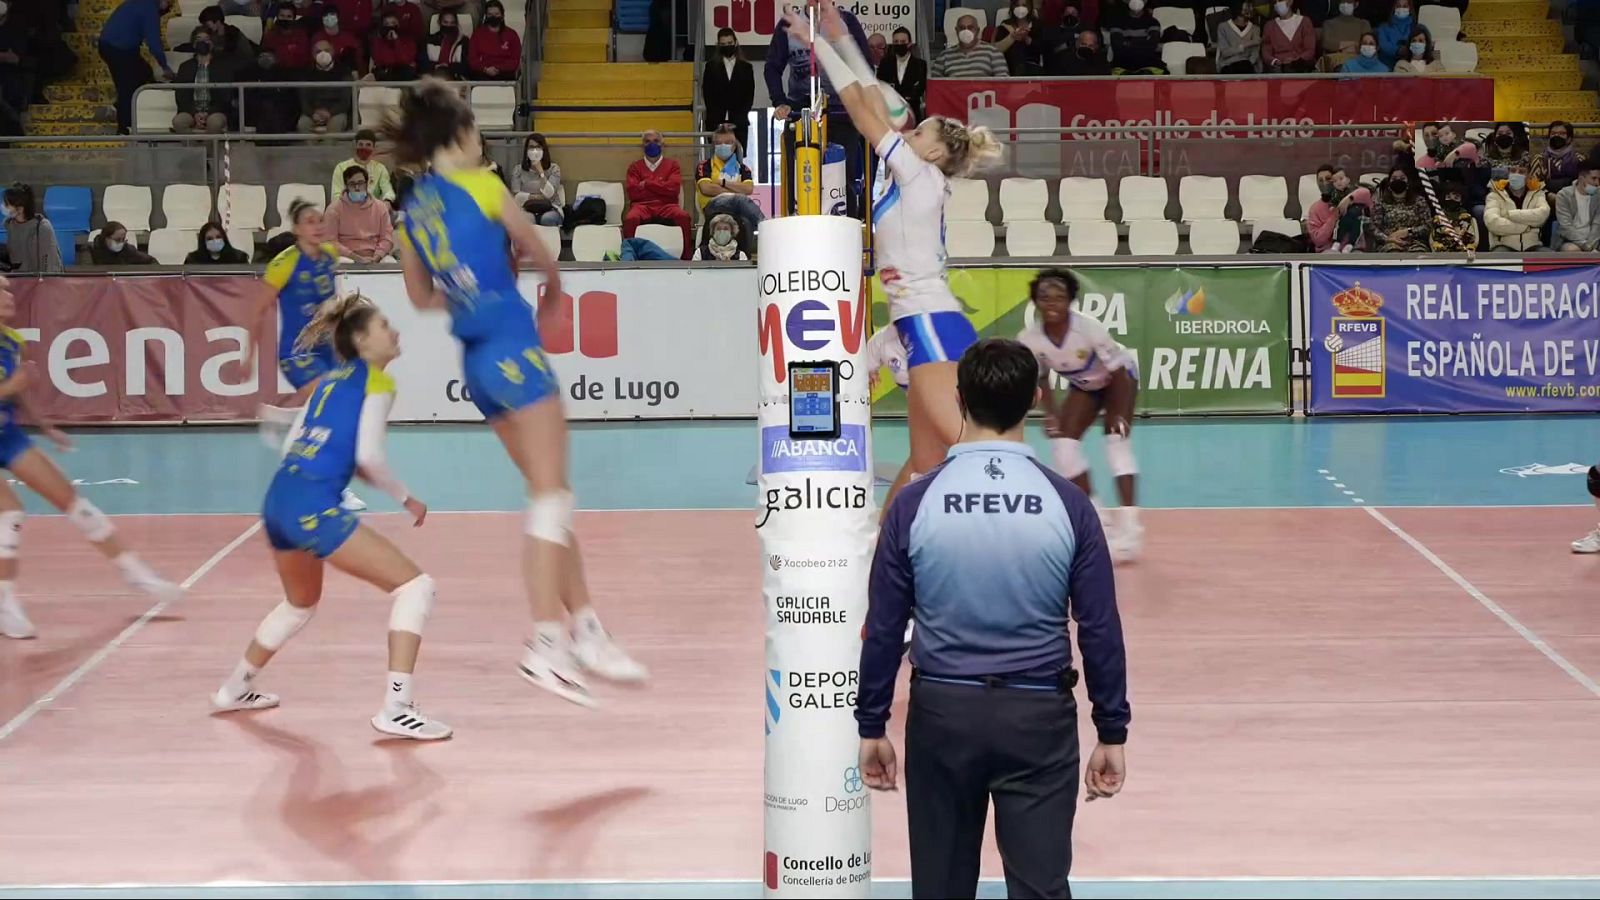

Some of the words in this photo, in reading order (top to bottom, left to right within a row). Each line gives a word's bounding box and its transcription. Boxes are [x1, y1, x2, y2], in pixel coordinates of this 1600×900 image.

[851, 2, 869, 16] de
[875, 3, 910, 20] Lugo
[1071, 110, 1190, 140] Concello
[1201, 110, 1236, 138] de
[1248, 112, 1314, 147] Lugo
[758, 270, 850, 297] VOLEIBOL
[1407, 283, 1469, 320] REAL
[1478, 282, 1598, 319] FEDERACI
[1175, 320, 1271, 334] IBERDROLA
[1338, 322, 1378, 333] RFEVB
[1407, 332, 1536, 377] ESPAÑOLA
[1544, 340, 1575, 376] DE
[1148, 347, 1272, 390] REINA
[570, 375, 604, 401] de
[614, 377, 680, 406] Lugo
[755, 478, 866, 529] galicia
[943, 493, 1043, 515] RFEVB
[784, 559, 826, 568] Xacobeo
[776, 596, 830, 609] GALICIA
[776, 610, 847, 624] SAUDABLE
[789, 670, 859, 688] DEPOR
[783, 856, 843, 871] Concello
[847, 853, 861, 869] de
[836, 876, 847, 885] de
